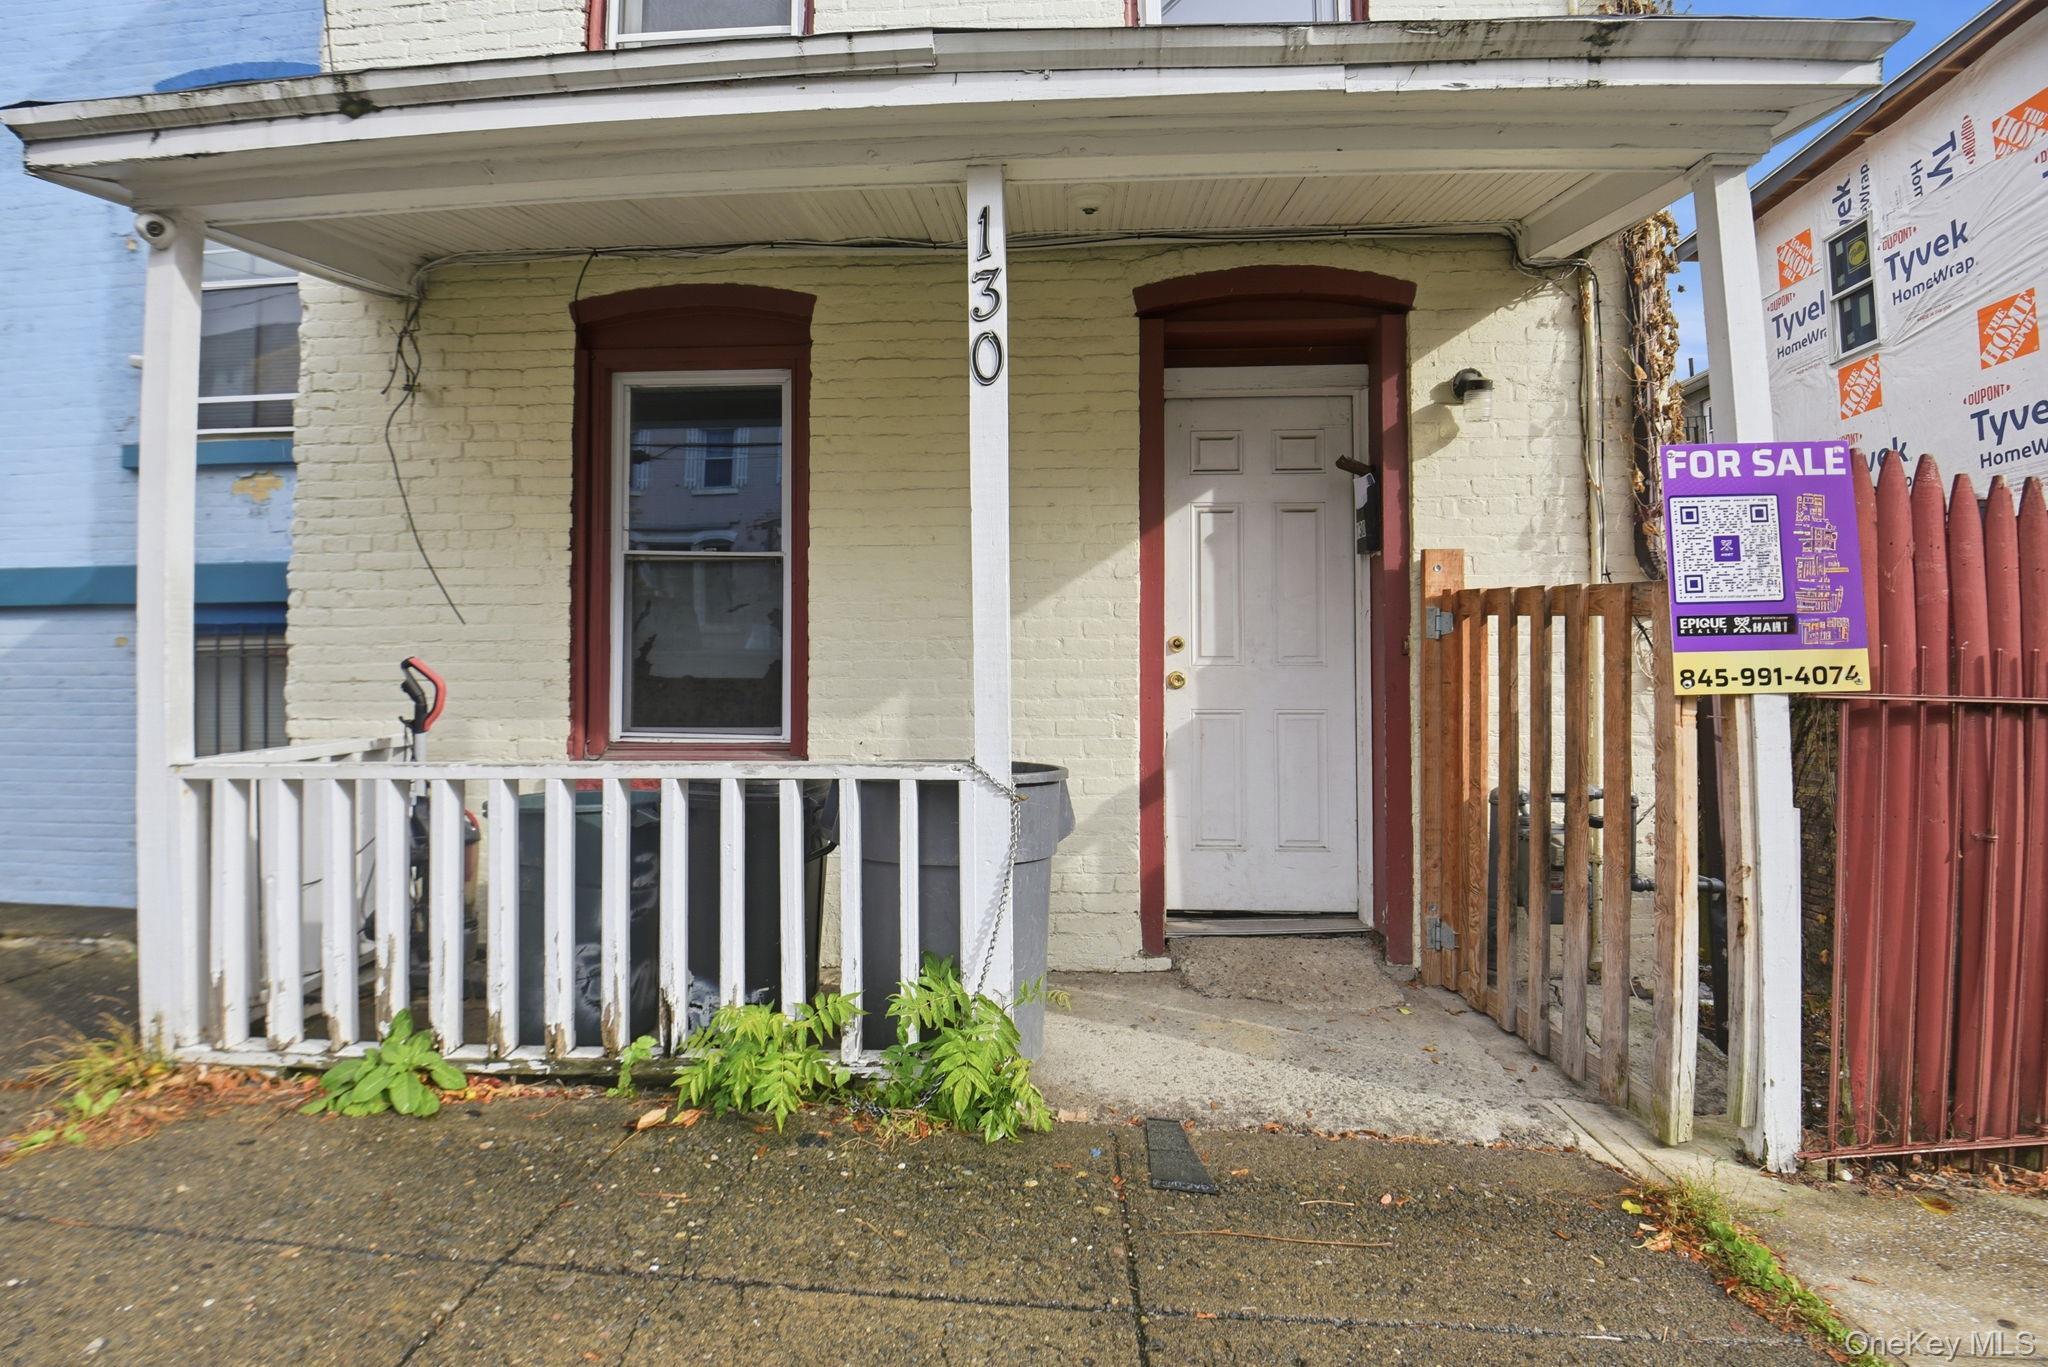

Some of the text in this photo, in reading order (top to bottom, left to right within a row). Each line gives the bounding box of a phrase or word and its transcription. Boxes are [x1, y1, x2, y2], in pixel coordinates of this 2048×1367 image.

[1882, 227, 1912, 251] DUPONT
[1884, 219, 1968, 282] Tyvek
[970, 204, 1004, 386] 130
[1892, 257, 1975, 306] HomeWrap
[1980, 292, 2034, 365] HOME
[1984, 307, 2007, 335] THE
[2002, 312, 2037, 359] DEPOT
[1840, 359, 1878, 416] HOME
[1843, 368, 1859, 392] THE
[1968, 384, 2005, 405] DUPONT
[1667, 446, 1846, 479] FOR SALE
[1680, 617, 1727, 629] EPIQUE
[1680, 665, 1861, 689] 845-991-4074
